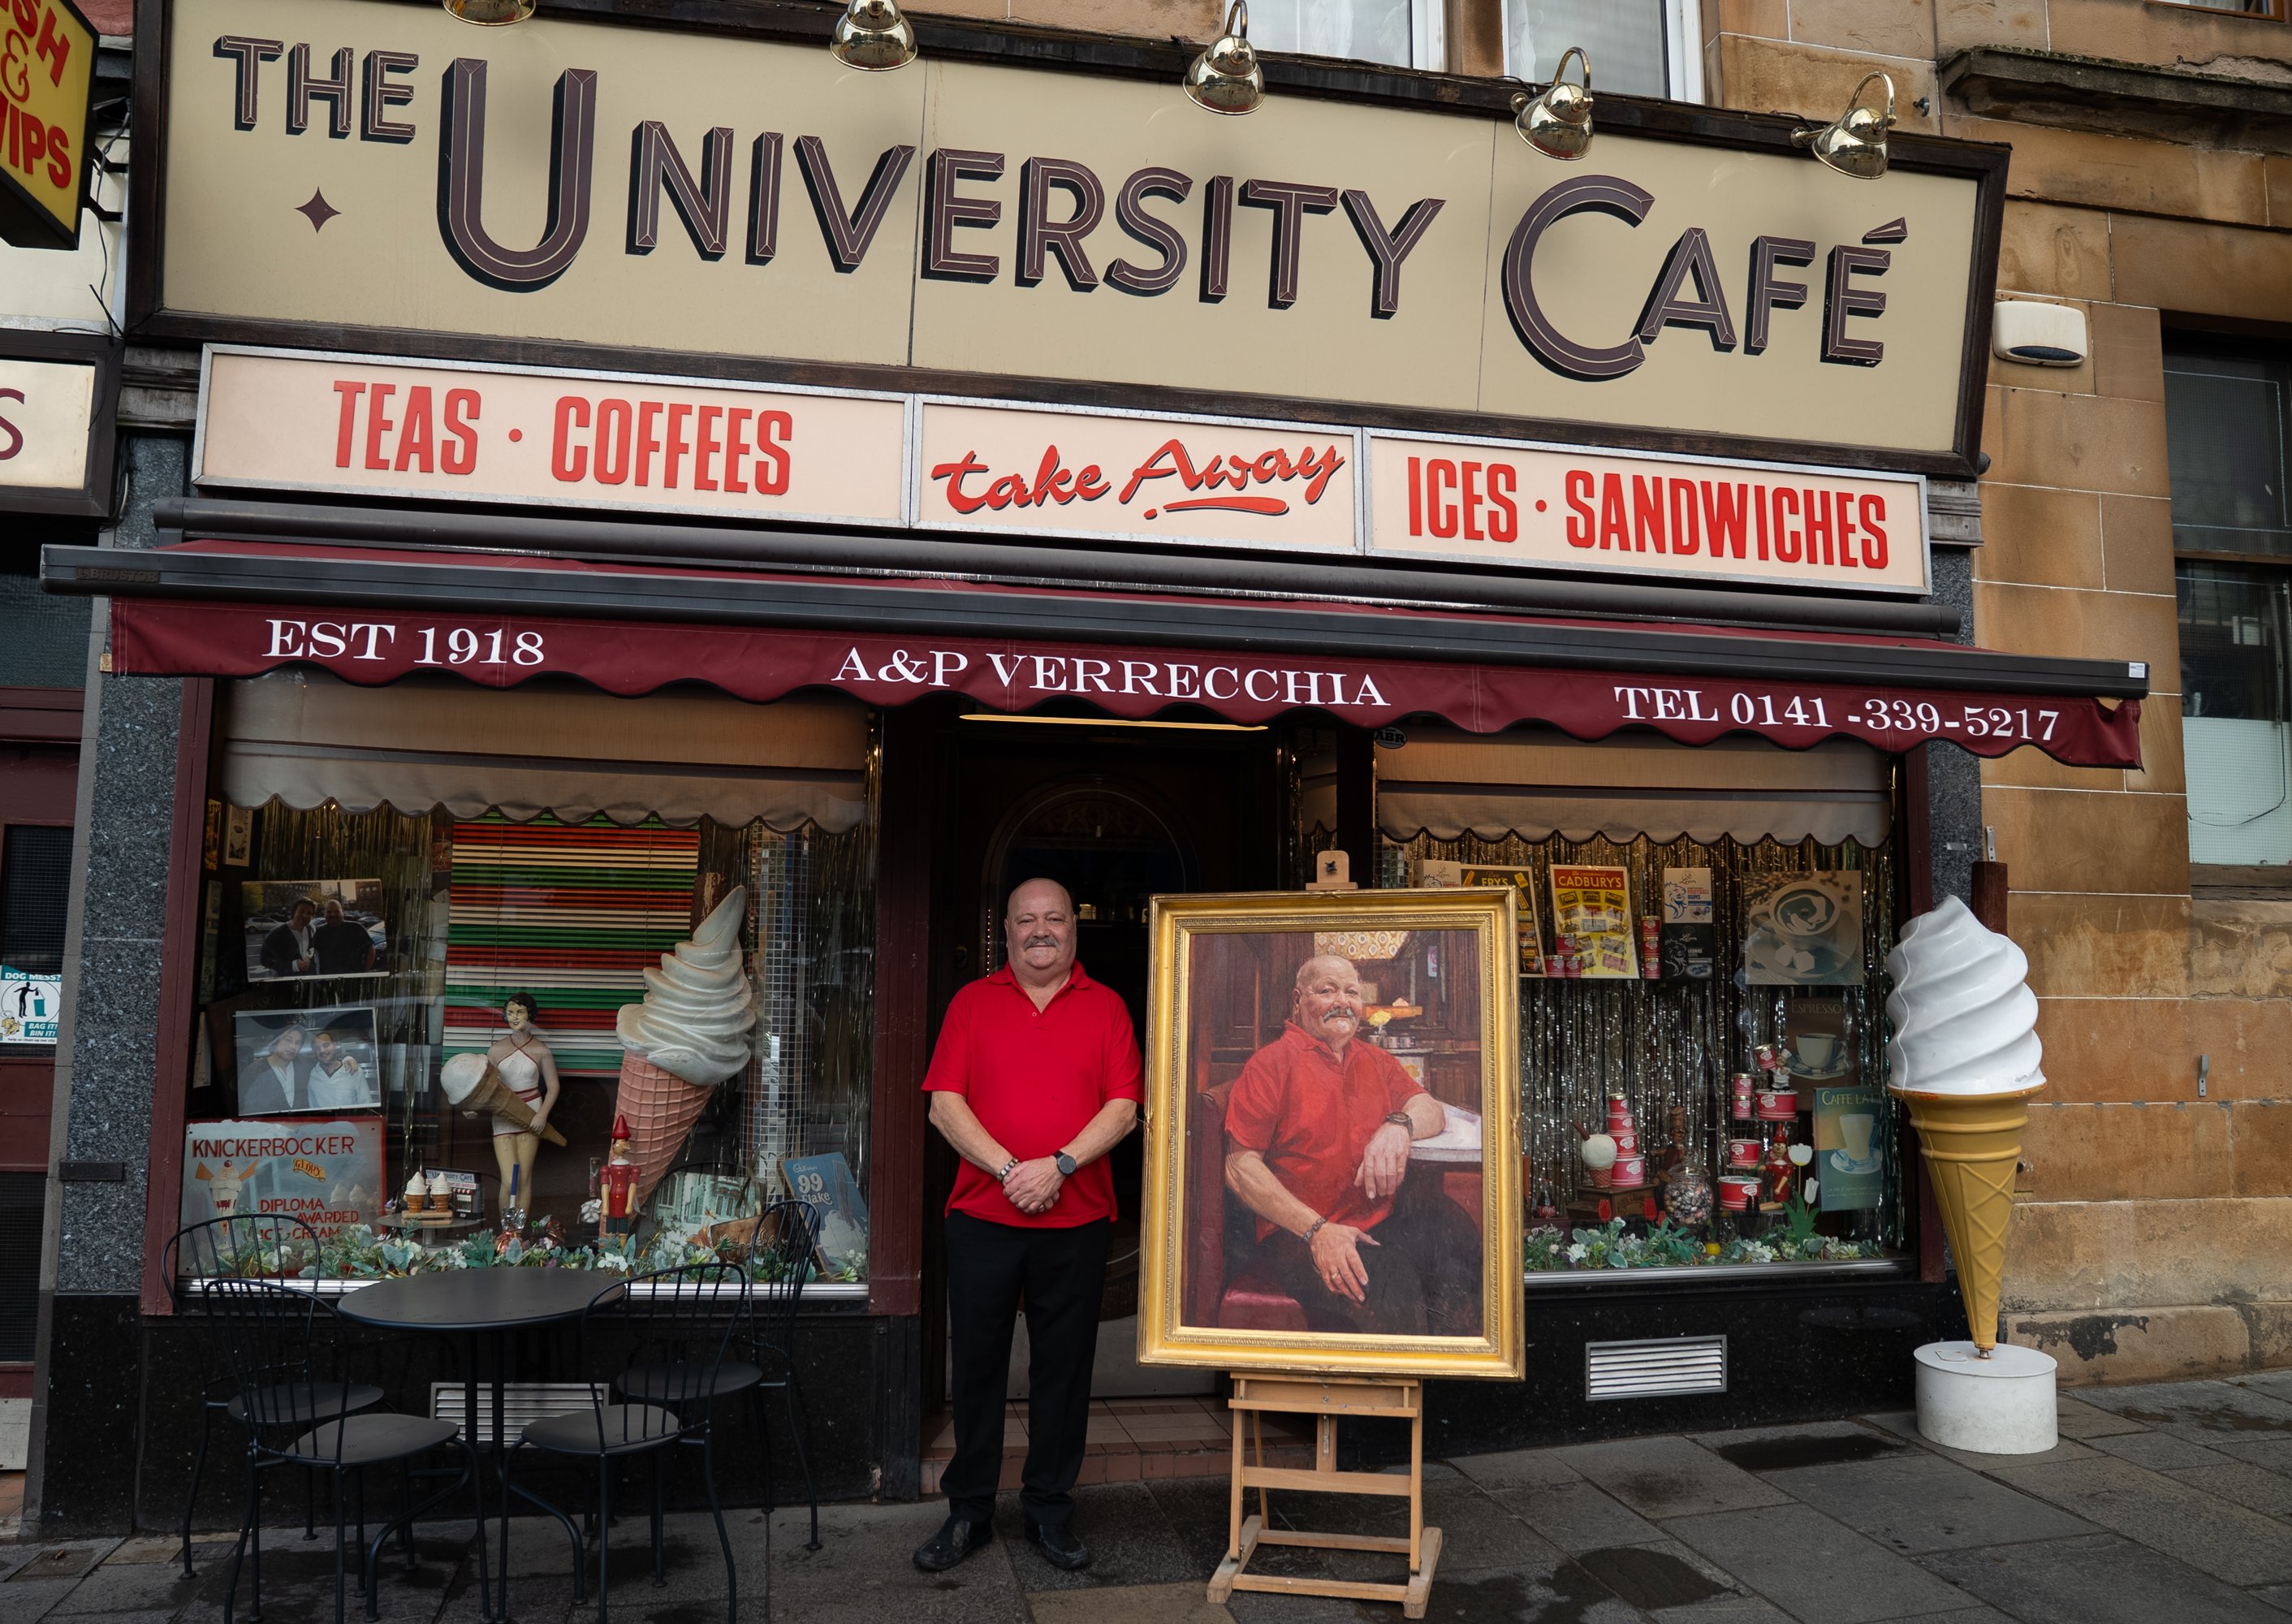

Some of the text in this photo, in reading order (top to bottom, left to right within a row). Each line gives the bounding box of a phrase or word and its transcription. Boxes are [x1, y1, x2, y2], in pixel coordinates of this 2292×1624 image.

[1, 28, 30, 103] &
[213, 35, 1908, 382] THE UNIVERSITY CAFÉ
[334, 381, 792, 495] TEAS COFFEES
[931, 439, 1345, 513] take Away
[1408, 457, 1888, 569] ICES SANDWICHES
[261, 620, 544, 666] EST 1918
[831, 647, 1391, 706] A&P VERRECCHIA
[1613, 687, 1719, 722] TEL
[1731, 693, 1833, 728] 0141
[1481, 877, 1509, 887] FRY'S
[1558, 875, 1622, 888] CADBURY'S
[1792, 1000, 1842, 1014] ESPRESSO
[192, 1137, 355, 1158] KNICKERBOCKER
[295, 1159, 323, 1177] GLORY
[798, 1173, 823, 1194] 99
[260, 1198, 326, 1212] DIPLOMA
[801, 1192, 833, 1205] Flake
[295, 1210, 360, 1224] AWARDED
